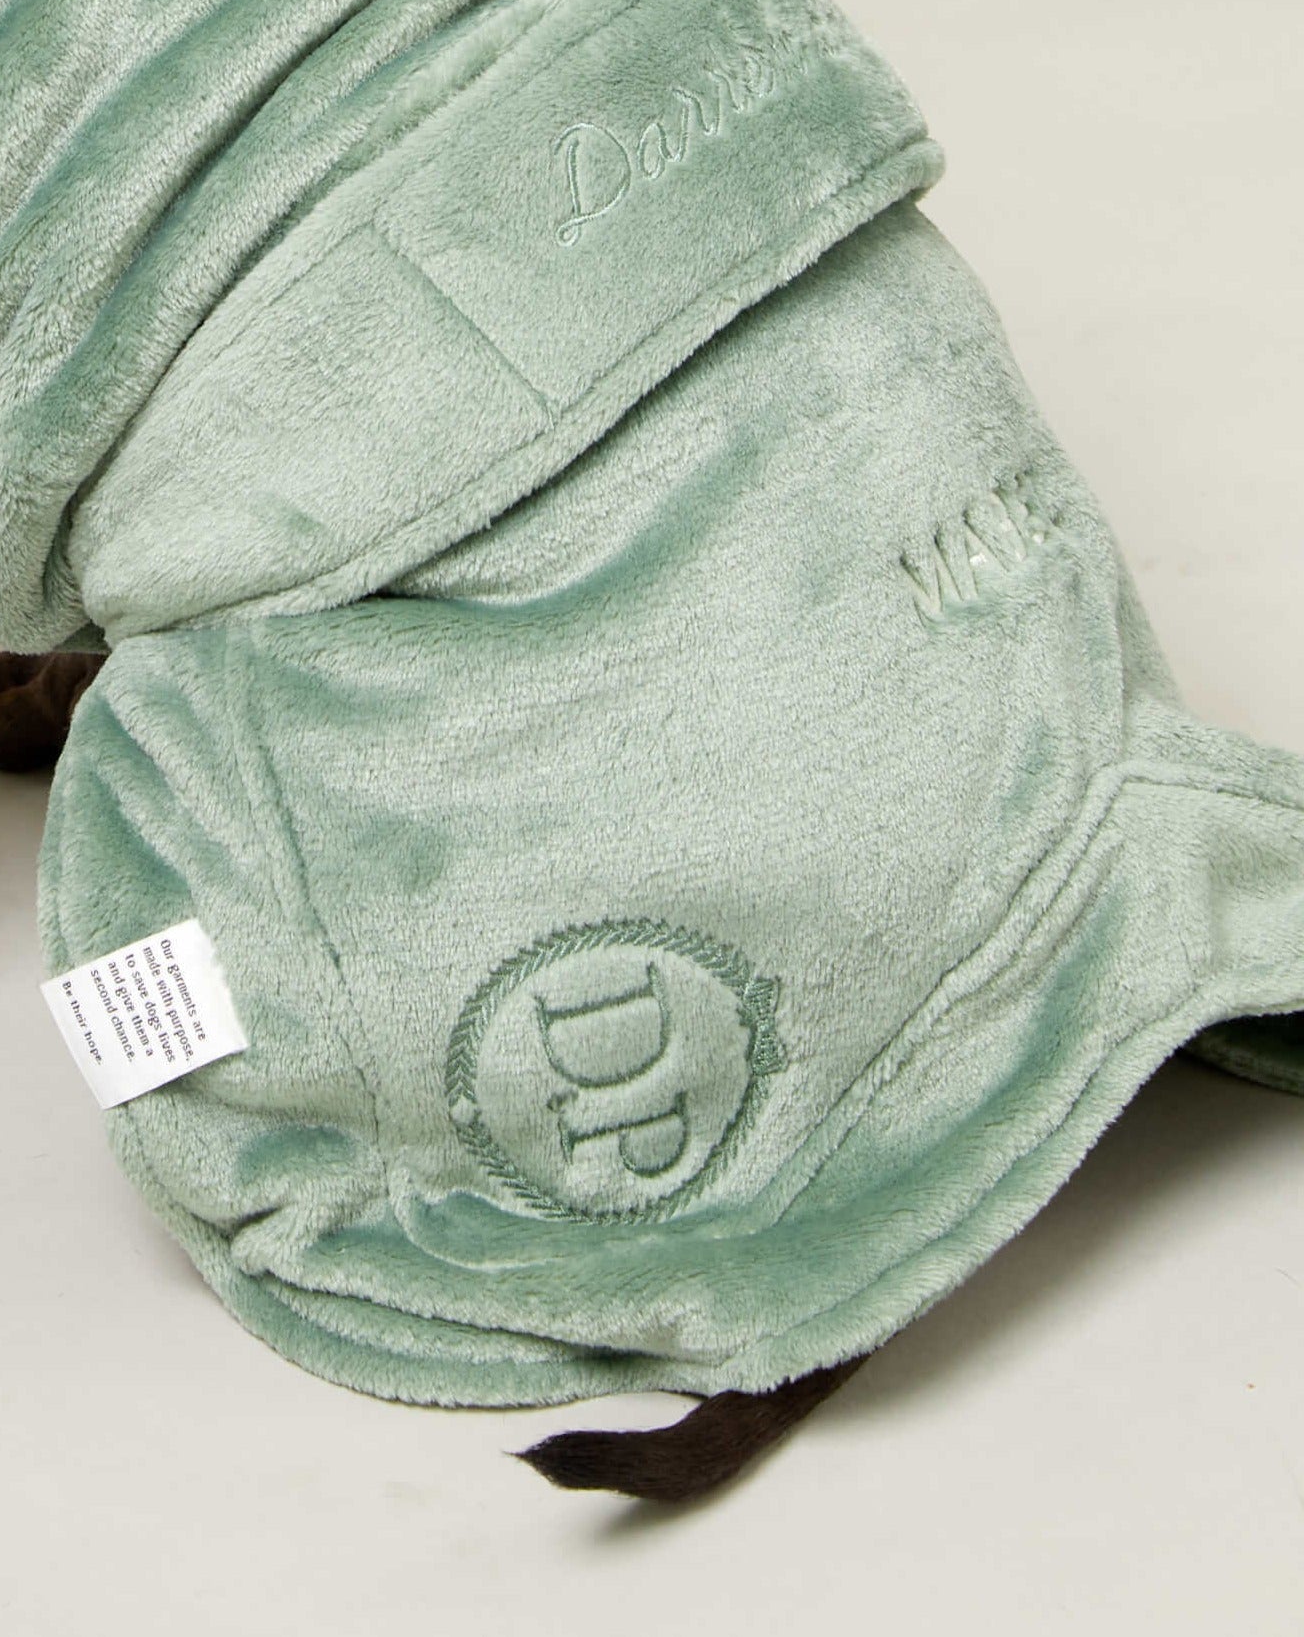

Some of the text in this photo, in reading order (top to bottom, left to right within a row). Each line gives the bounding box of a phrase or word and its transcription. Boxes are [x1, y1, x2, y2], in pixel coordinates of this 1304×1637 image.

[62, 981, 73, 997] Be
[70, 1000, 87, 1028] their
[91, 969, 136, 1063] second chance.
[108, 961, 154, 1057] and give them a
[125, 953, 176, 1063] to save dogs lives
[143, 946, 161, 977] made
[156, 979, 174, 1008] with
[160, 938, 206, 1041] Our garments are
